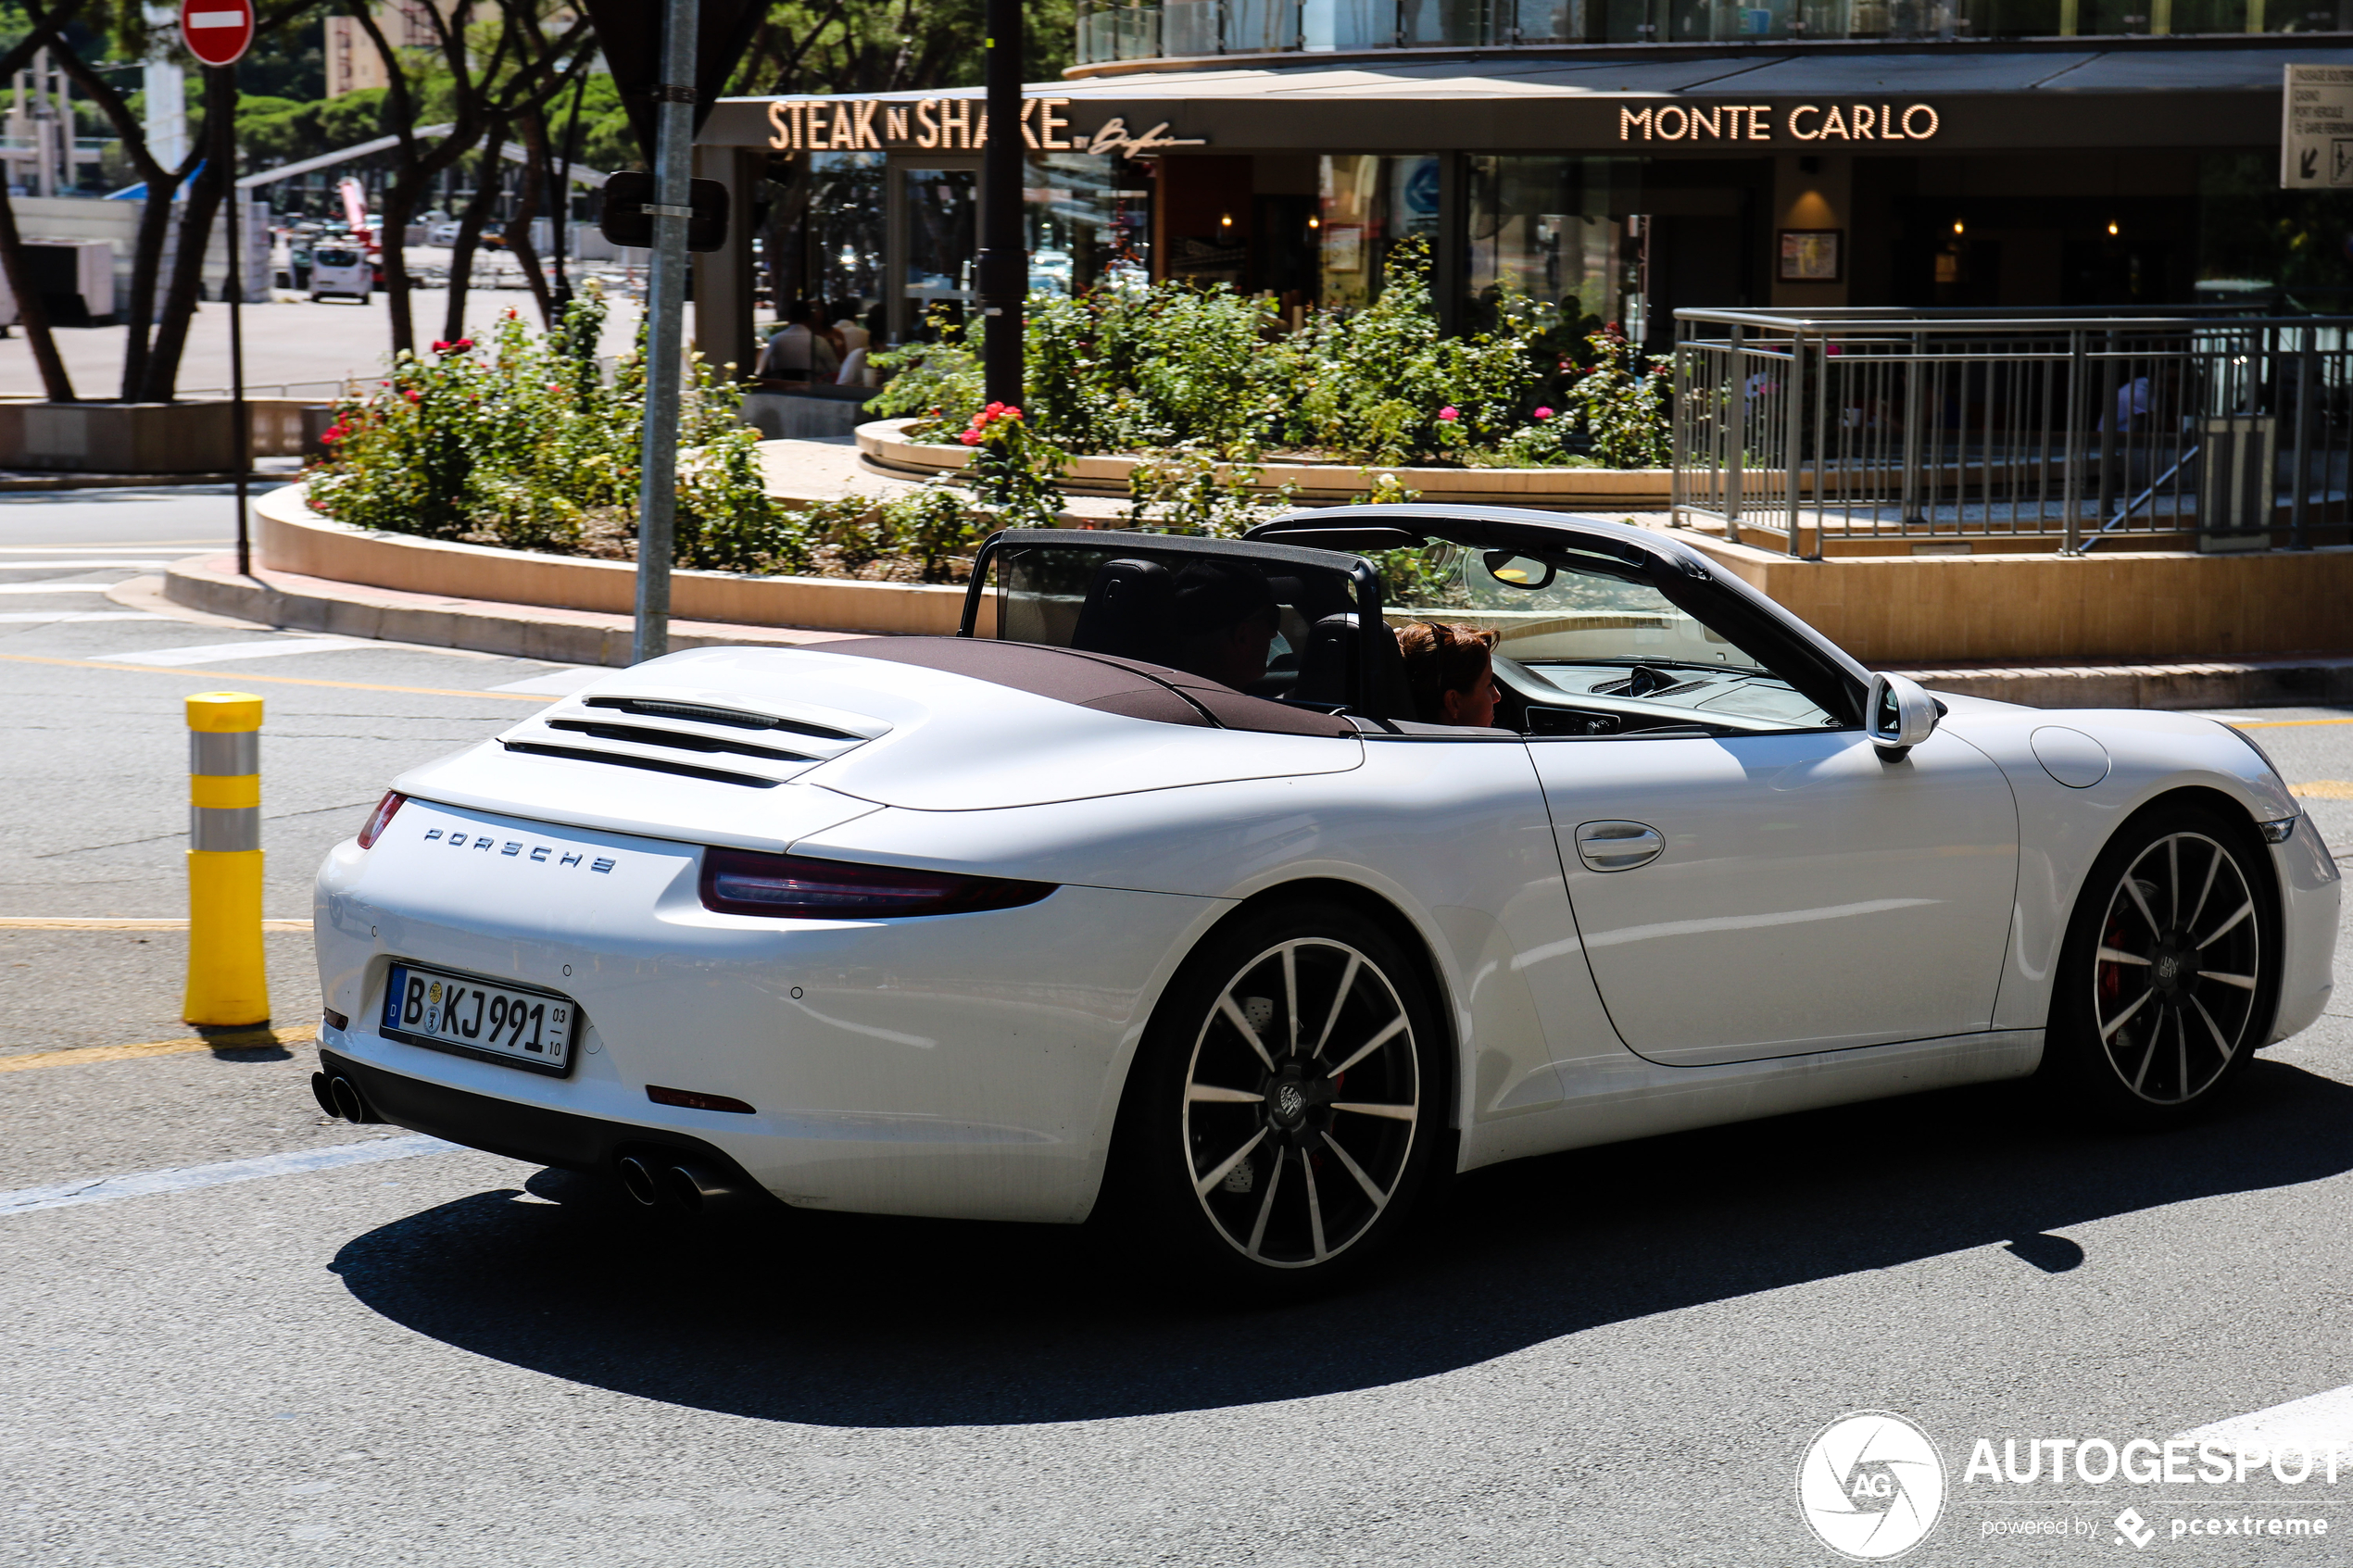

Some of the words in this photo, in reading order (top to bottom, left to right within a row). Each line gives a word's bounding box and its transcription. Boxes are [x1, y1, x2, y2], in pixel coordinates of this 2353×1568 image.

[768, 99, 881, 149] STEAK
[887, 106, 909, 140] N
[1620, 104, 1771, 140] MONTE
[1788, 103, 1940, 140] CARLO
[423, 827, 617, 874] PORSCHE
[403, 976, 425, 1024] B
[552, 1008, 565, 1023] 03
[549, 1041, 560, 1056] 10
